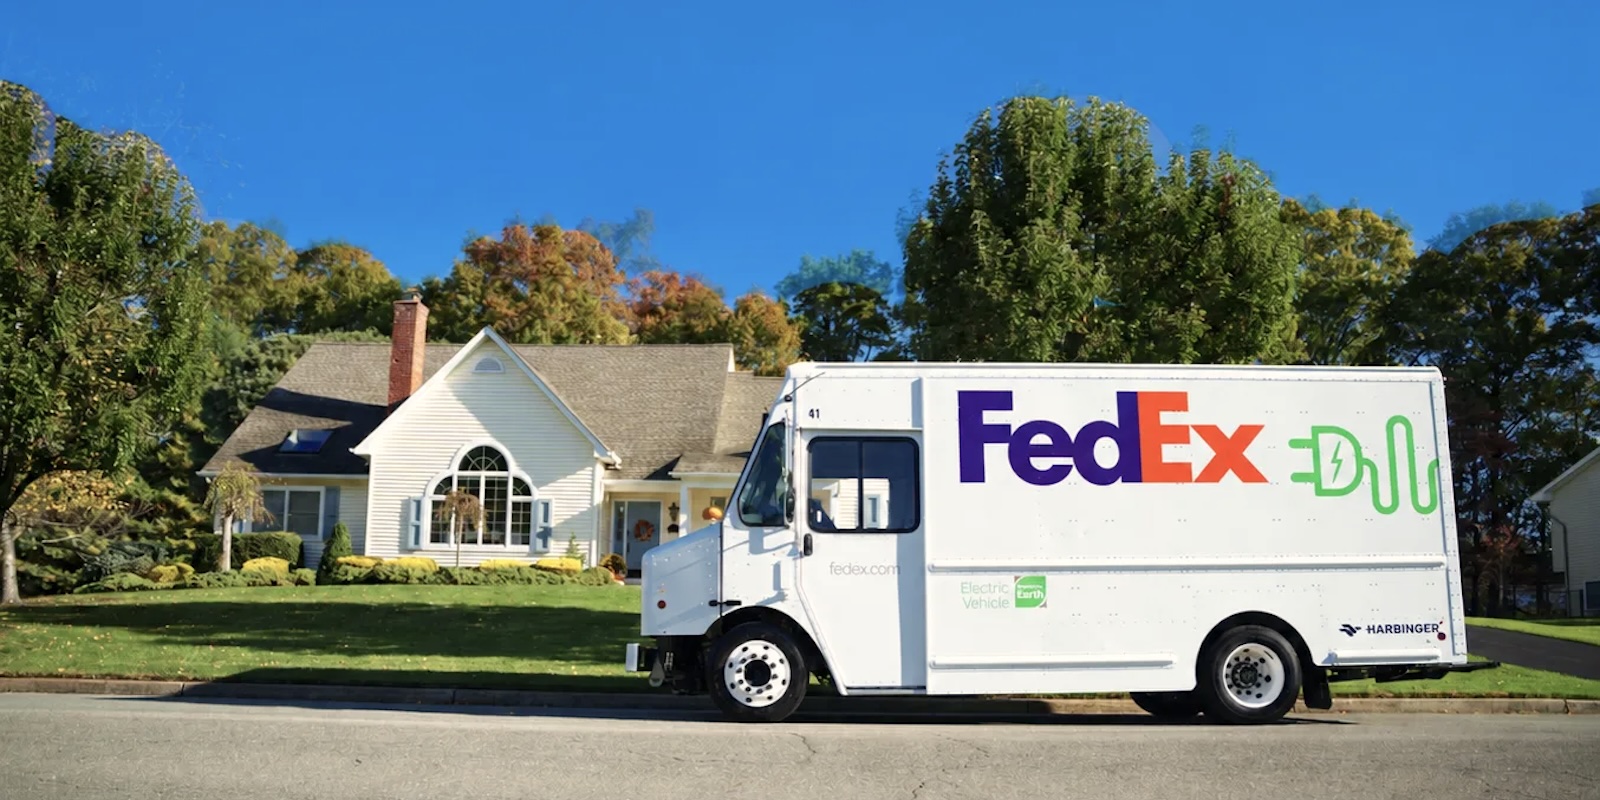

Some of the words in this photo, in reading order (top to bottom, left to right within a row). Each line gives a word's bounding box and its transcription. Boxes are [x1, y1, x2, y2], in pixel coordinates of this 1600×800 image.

[808, 408, 820, 419] 41
[957, 389, 1269, 486] FedEx
[829, 561, 901, 576] fedex.com
[960, 582, 1009, 594] Electric
[1016, 590, 1044, 599] Earth
[962, 596, 1010, 609] Vehicle
[1366, 624, 1439, 634] HARBINGER
